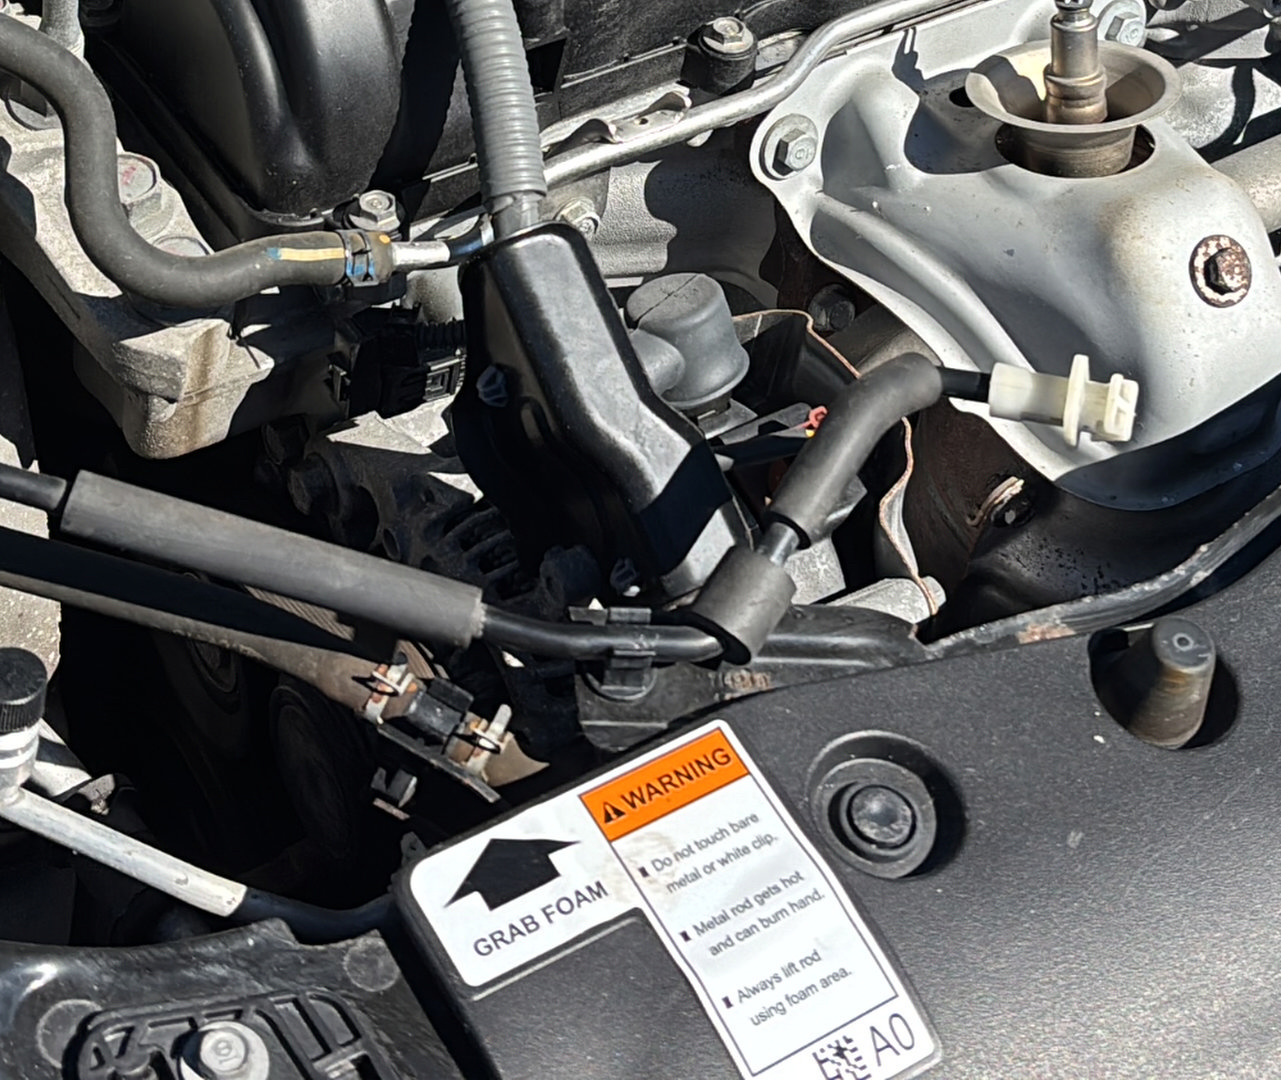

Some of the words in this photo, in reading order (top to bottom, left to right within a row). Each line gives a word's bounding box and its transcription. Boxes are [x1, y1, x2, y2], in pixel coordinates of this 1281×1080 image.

[621, 748, 732, 809] WARNING
[651, 857, 672, 873] Do
[674, 845, 695, 863] not
[694, 827, 729, 853] touch
[728, 812, 760, 836] bare
[666, 865, 702, 894] metal
[701, 861, 718, 875] or
[719, 845, 751, 870] white
[751, 832, 780, 855] clip.
[473, 915, 541, 956] GRAB
[541, 880, 609, 925] FOAM
[692, 908, 731, 937] Metal
[730, 897, 754, 917] rod
[753, 882, 782, 907] gets
[781, 869, 805, 890] hot
[709, 936, 735, 956] and
[735, 923, 760, 943] can
[761, 906, 790, 930] burn
[790, 887, 826, 914] hand.
[736, 969, 783, 1004] Always
[780, 961, 797, 980] lift
[799, 947, 823, 970] rod
[750, 1000, 787, 1027] using
[785, 982, 820, 1008] foam
[820, 966, 853, 989] area.
[869, 1012, 915, 1067] A0
